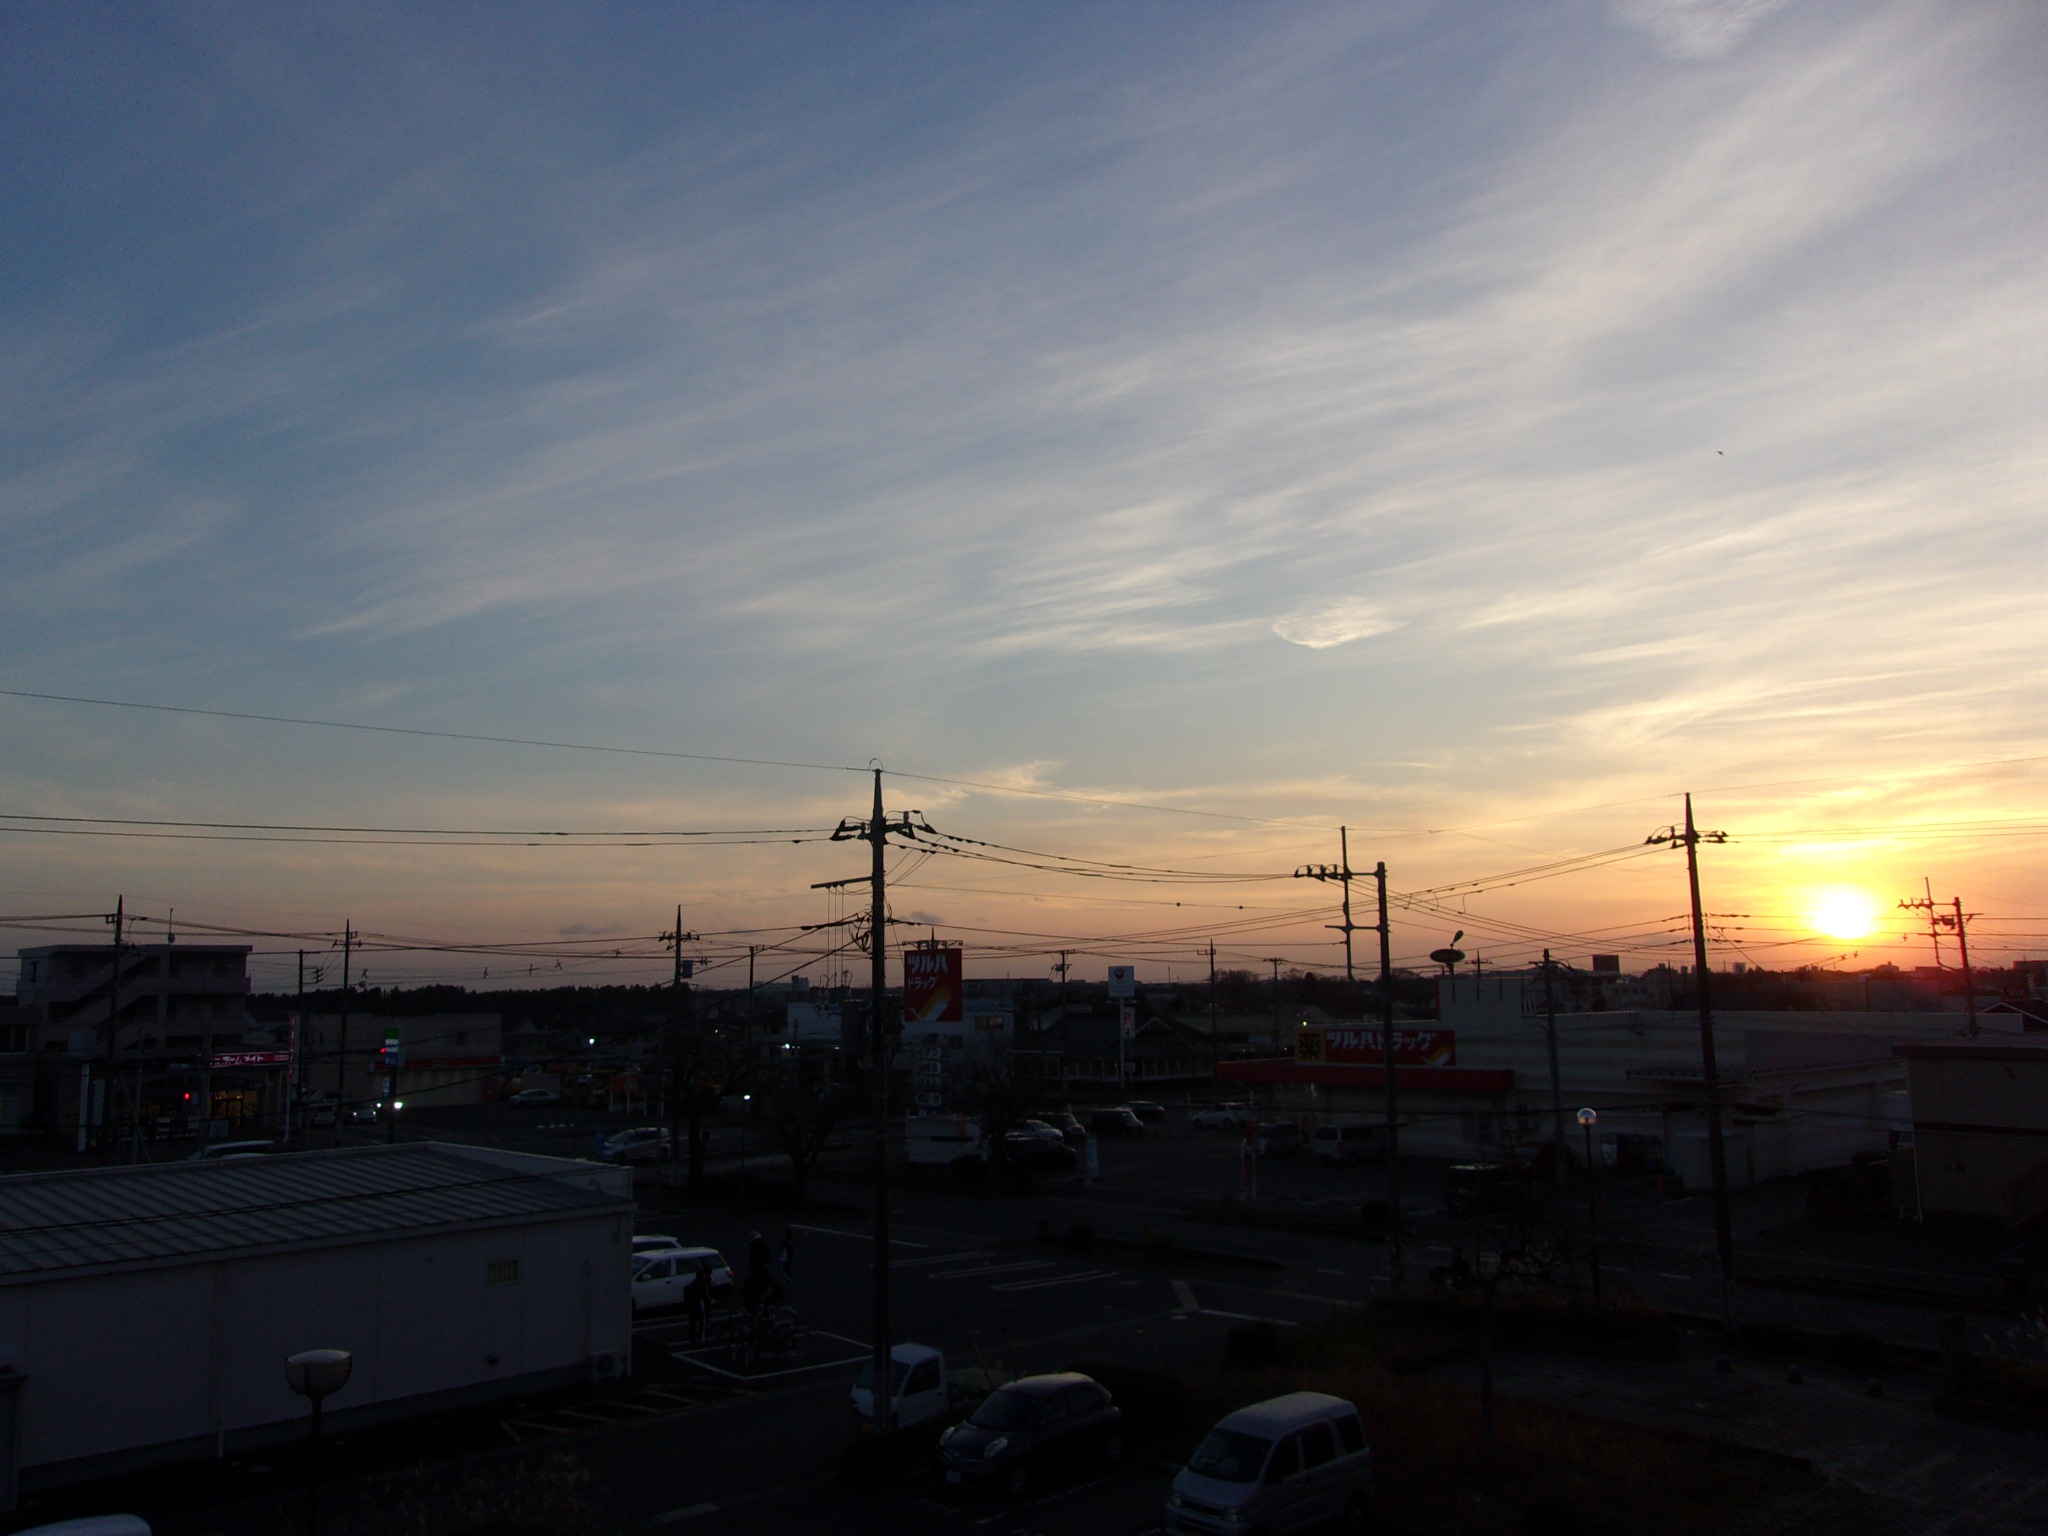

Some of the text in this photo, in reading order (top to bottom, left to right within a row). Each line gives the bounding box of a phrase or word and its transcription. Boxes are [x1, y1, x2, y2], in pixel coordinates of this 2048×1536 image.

[907, 953, 949, 974] ツルハ
[907, 975, 939, 990] ドラッグ
[1123, 1012, 1131, 1024] P
[1298, 1032, 1321, 1060] 薬
[1326, 1030, 1438, 1051] ツルハドラッグ
